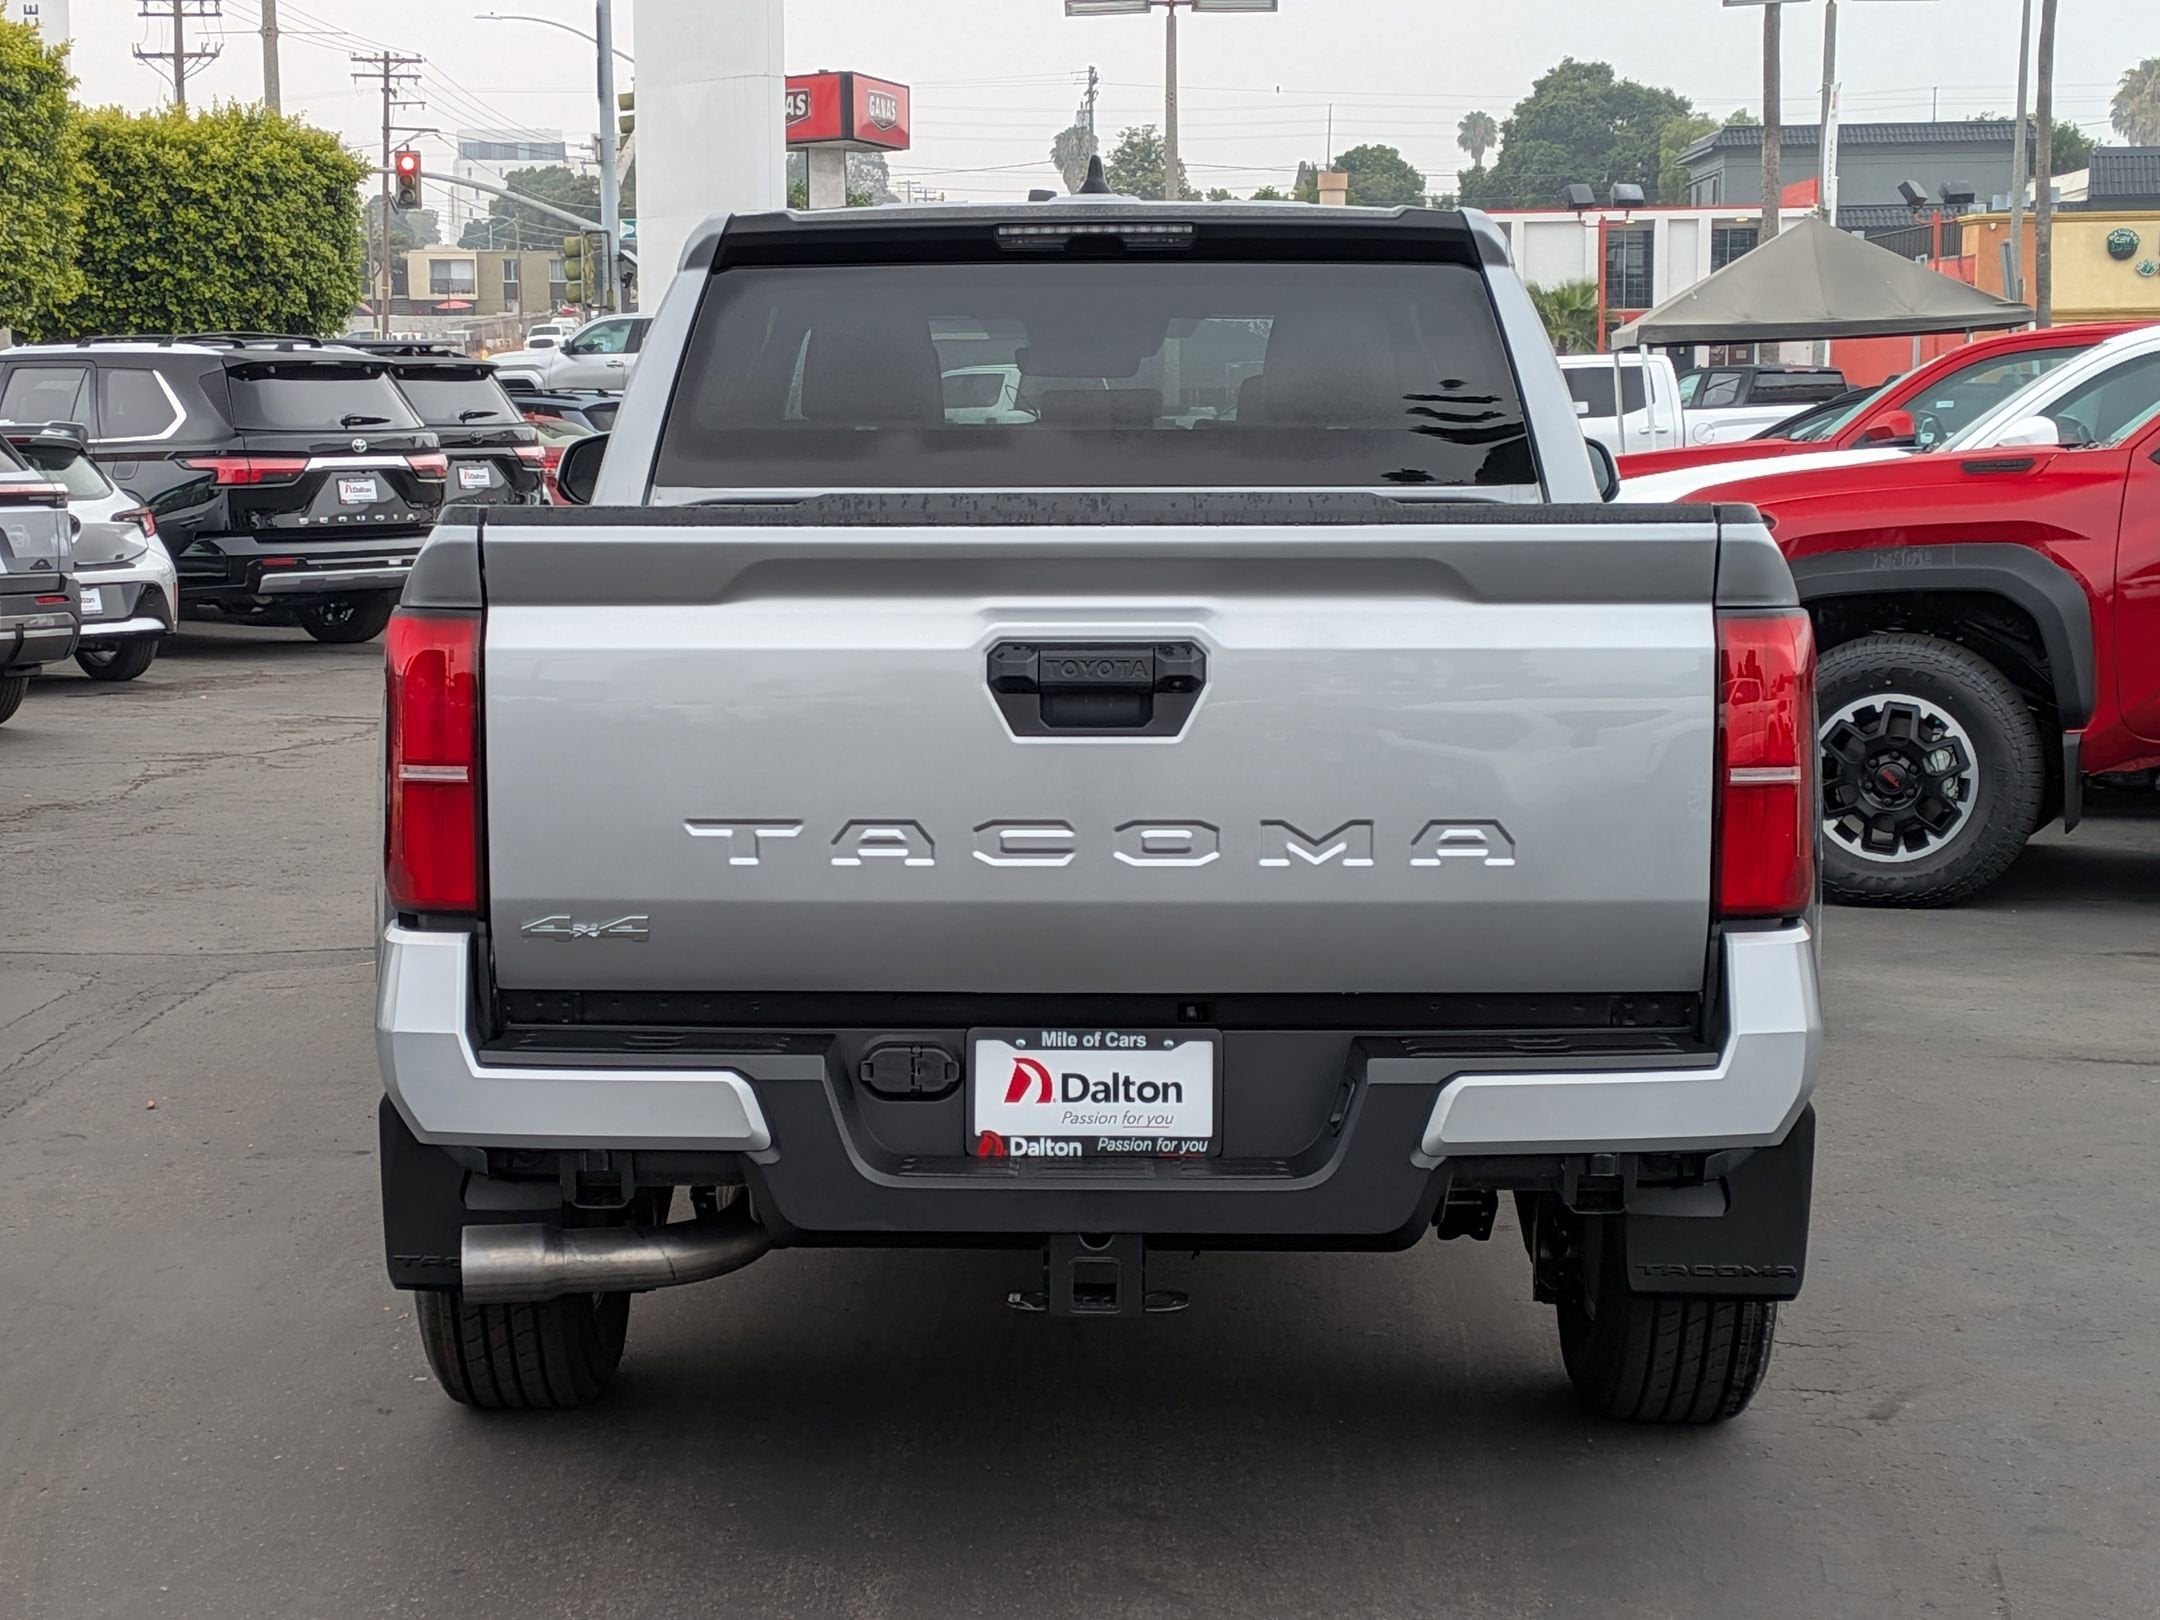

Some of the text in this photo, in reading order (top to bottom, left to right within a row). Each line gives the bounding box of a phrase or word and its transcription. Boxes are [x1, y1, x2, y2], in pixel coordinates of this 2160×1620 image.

[868, 95, 896, 122] GANAS
[1045, 659, 1149, 679] TOYOTA
[684, 818, 1517, 868] TACOMA
[1041, 1031, 1147, 1048] Mile of Cars
[1060, 1071, 1183, 1104] Dalton
[1060, 1110, 1175, 1129] Passion for you
[1009, 1137, 1083, 1157] Dalton
[1097, 1137, 1209, 1156] Passion for you
[1633, 1262, 1798, 1279] TACOMA
